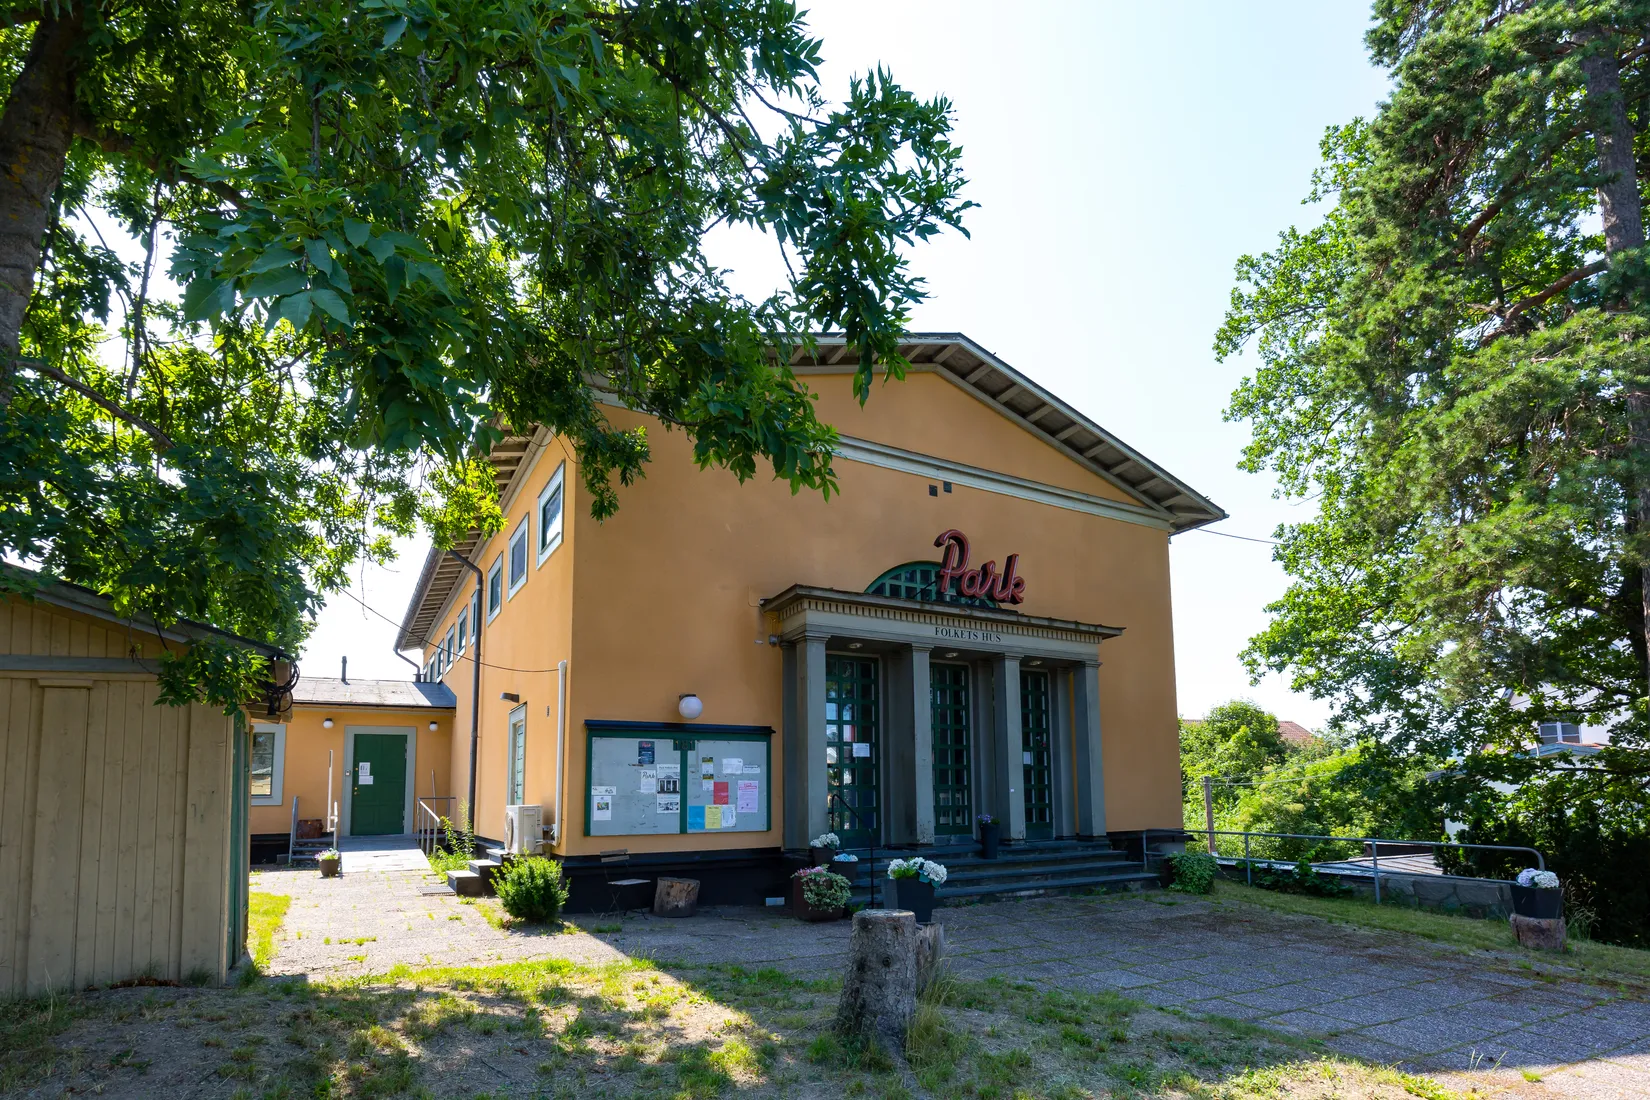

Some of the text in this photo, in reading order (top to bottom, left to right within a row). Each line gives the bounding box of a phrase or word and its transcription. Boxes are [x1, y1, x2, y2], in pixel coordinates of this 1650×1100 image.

[933, 529, 1026, 604] Park
[935, 627, 1001, 642] FOLKETS HUS
